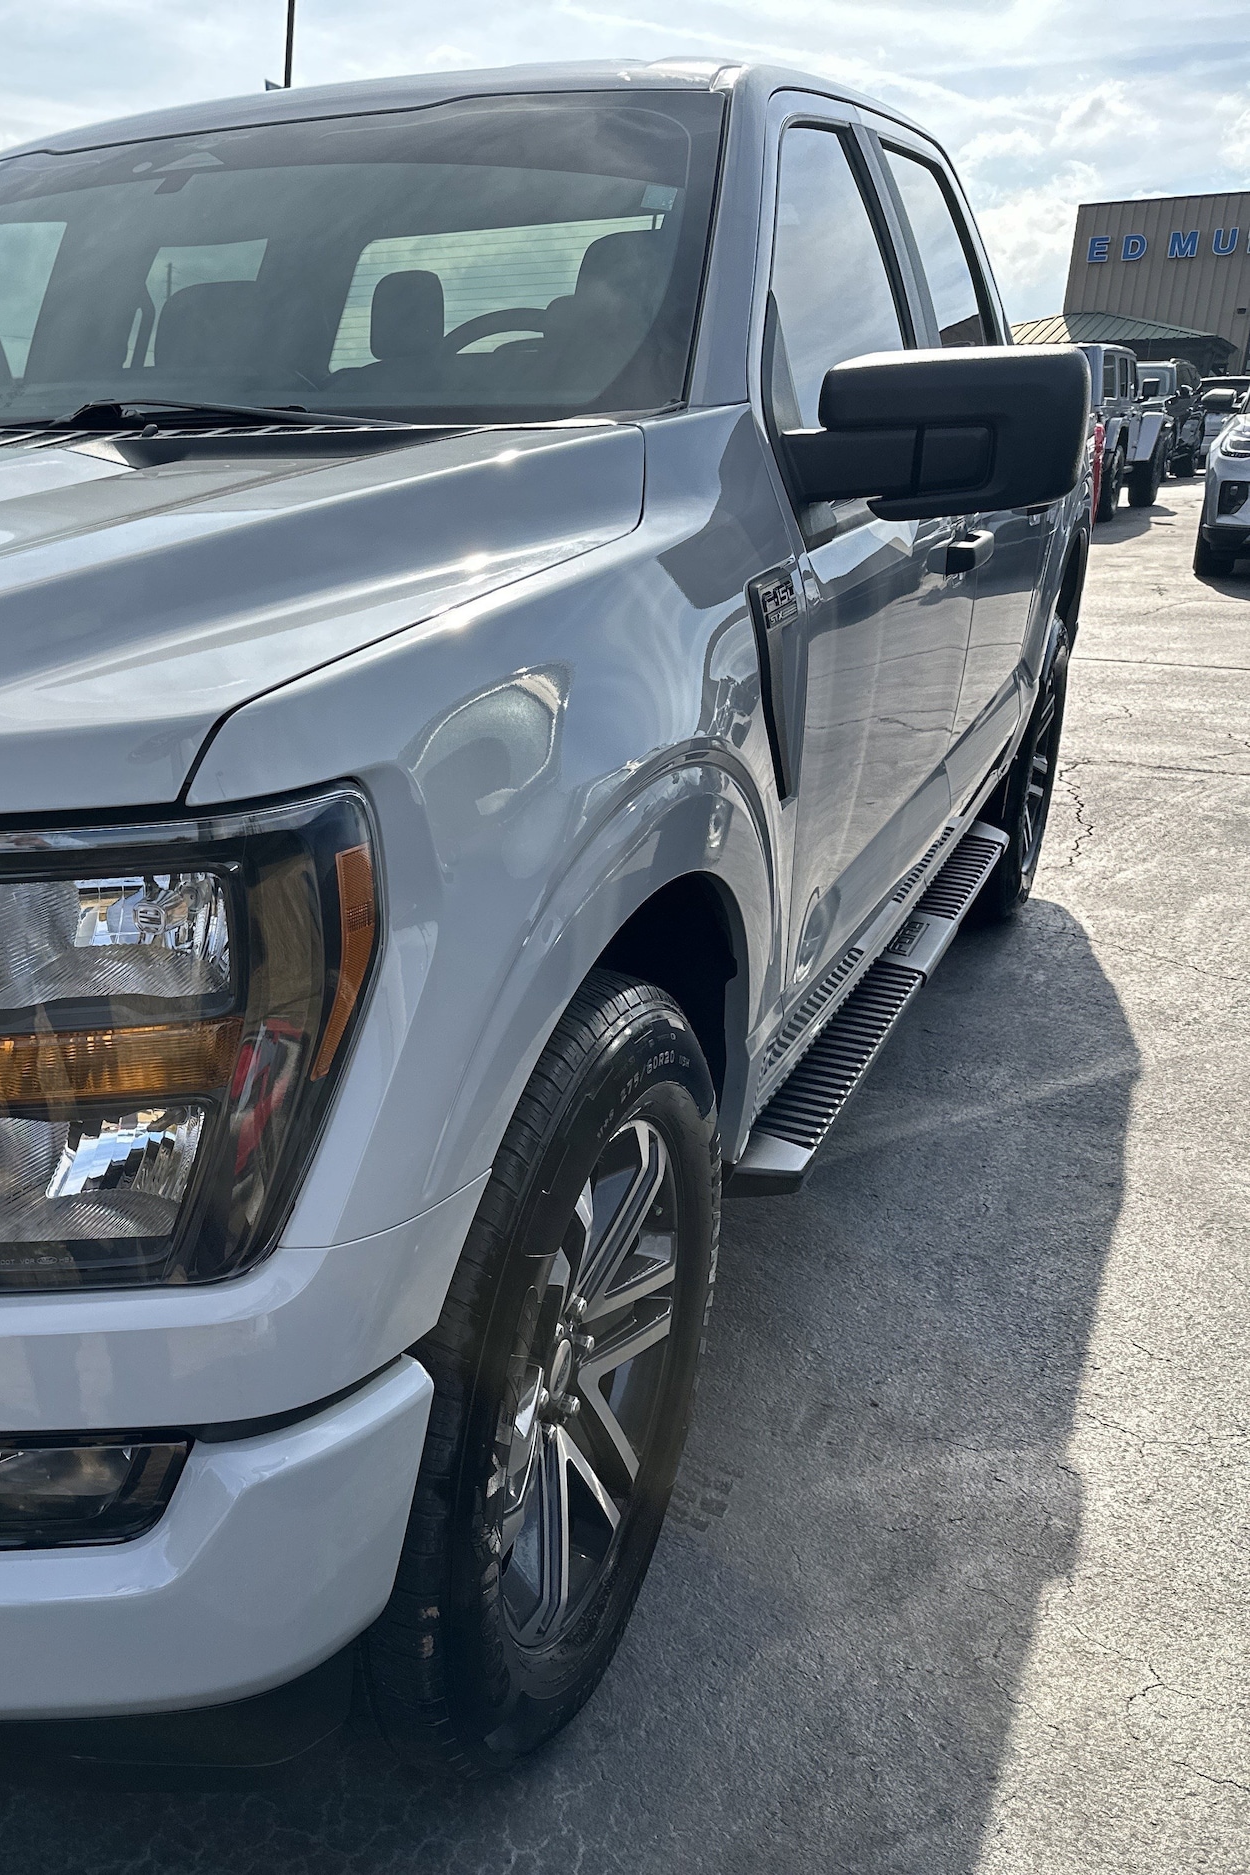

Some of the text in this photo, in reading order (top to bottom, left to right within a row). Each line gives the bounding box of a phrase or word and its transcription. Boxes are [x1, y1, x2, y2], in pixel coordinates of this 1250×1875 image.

[1086, 226, 1250, 263] ED MU
[770, 611, 783, 624] STX
